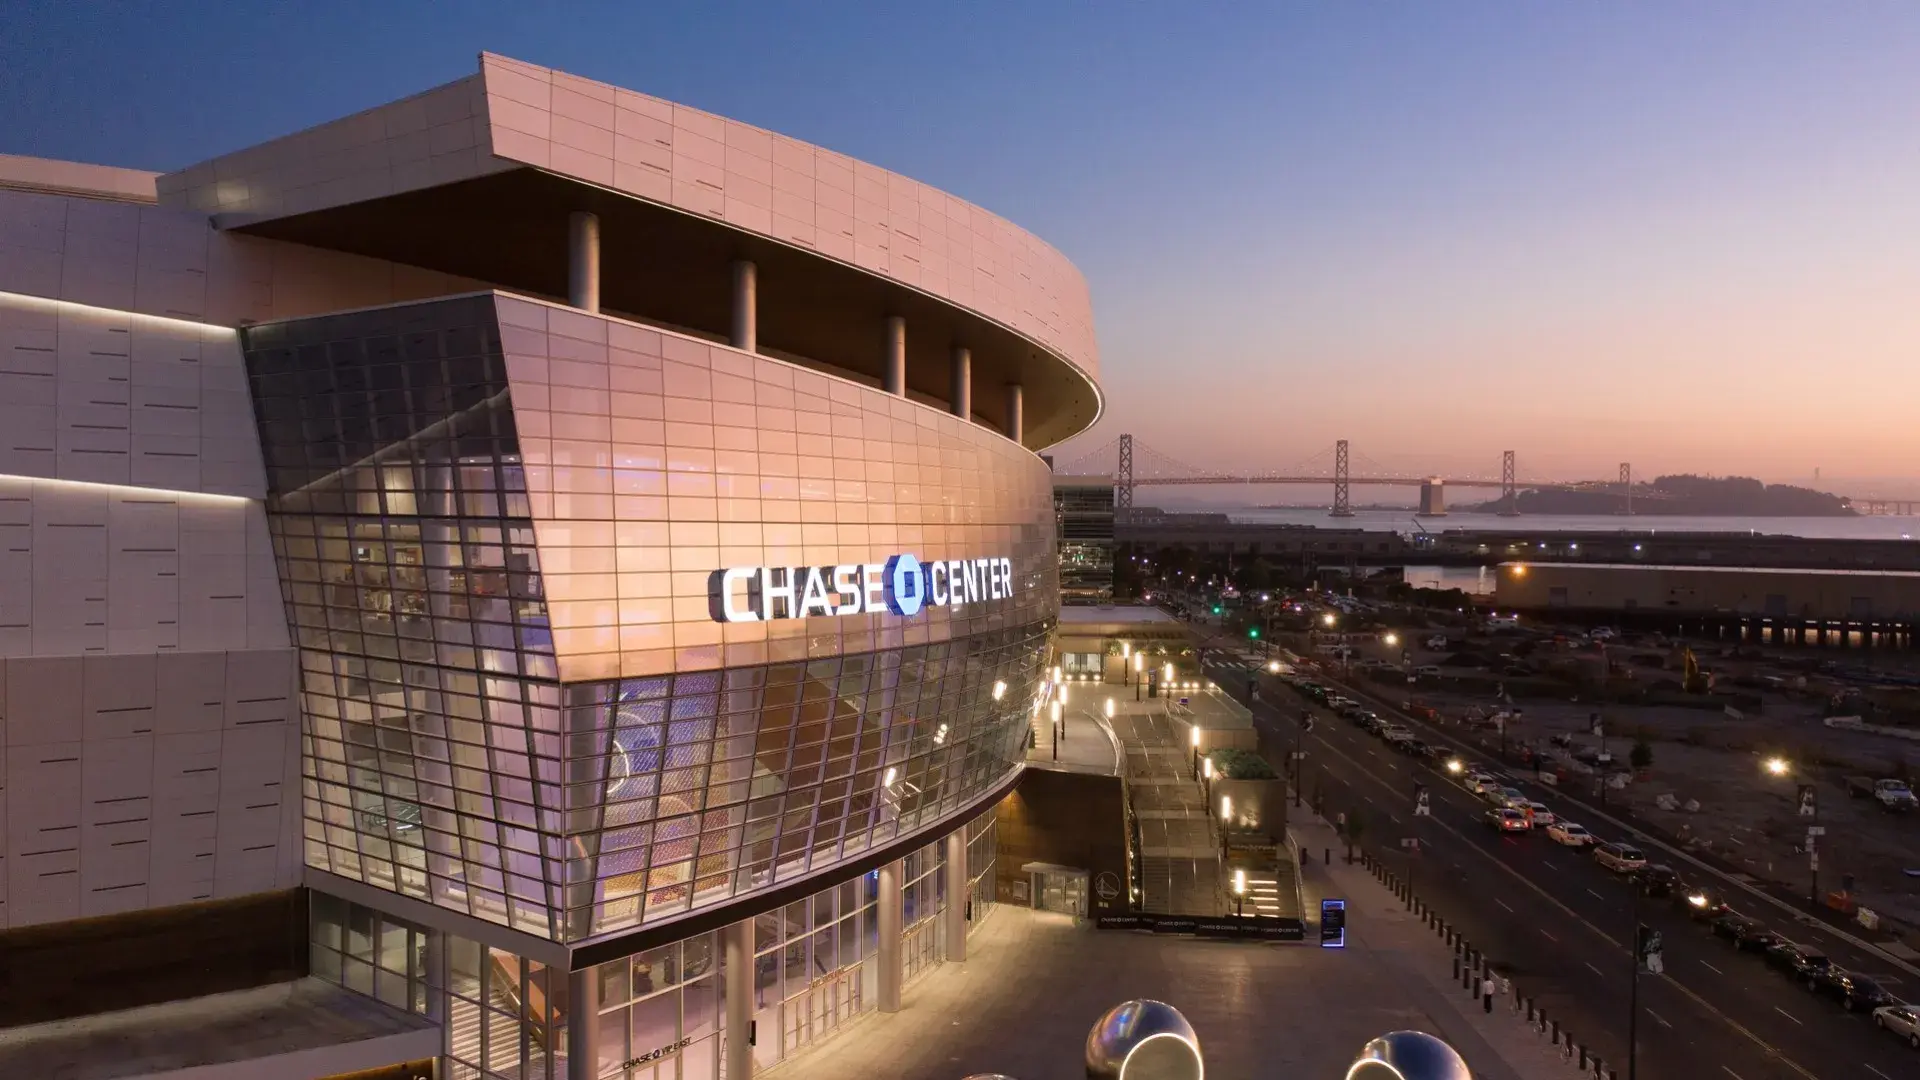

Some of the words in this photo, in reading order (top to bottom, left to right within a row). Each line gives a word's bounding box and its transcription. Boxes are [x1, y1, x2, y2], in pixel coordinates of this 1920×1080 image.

[721, 563, 886, 623] CHASE
[931, 557, 1013, 607] CENTER
[622, 1052, 652, 1070] CHASE
[661, 1045, 673, 1055] VIP
[673, 1037, 691, 1050] EAST
